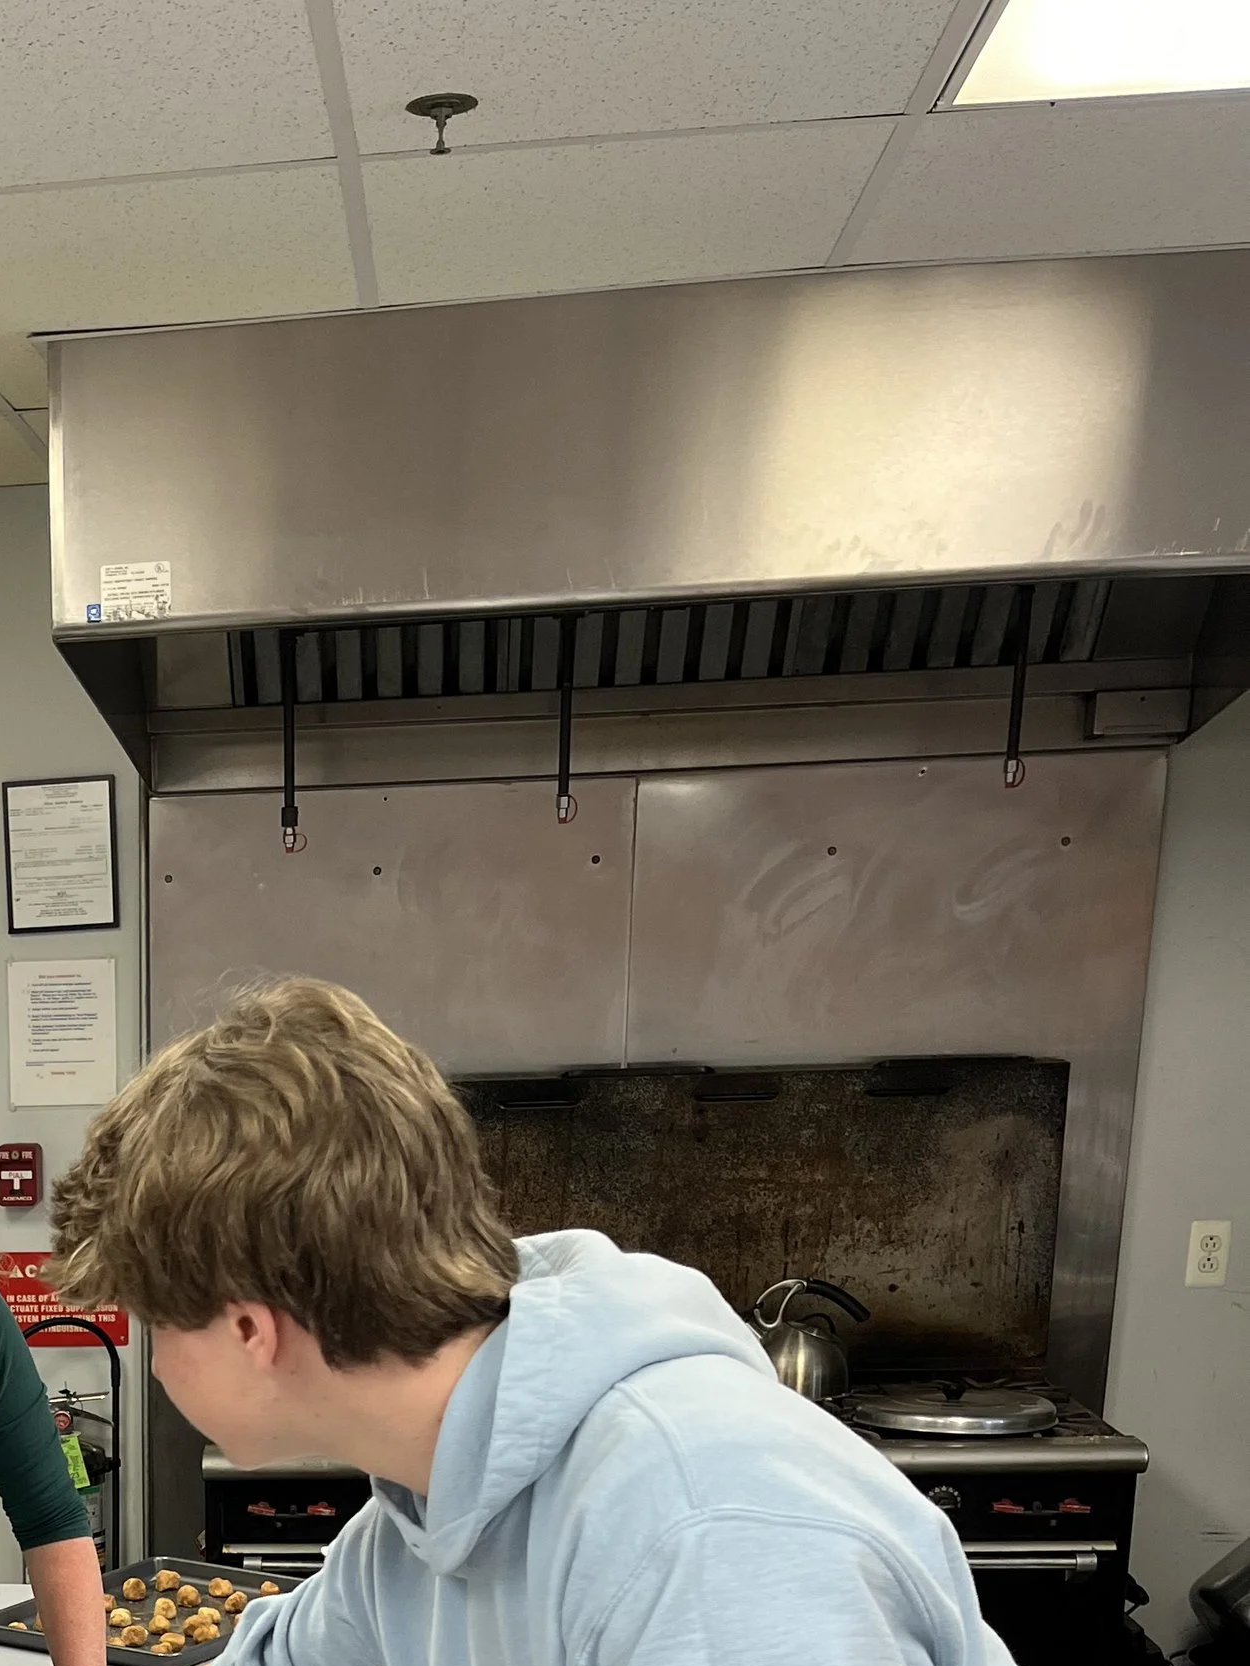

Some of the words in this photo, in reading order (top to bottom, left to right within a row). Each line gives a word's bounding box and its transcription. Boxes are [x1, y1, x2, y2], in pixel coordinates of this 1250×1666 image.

[0, 1152, 10, 1160] FIRE
[6, 1295, 14, 1303] IN
[10, 1305, 39, 1313] CTUATE
[41, 1305, 64, 1313] FIXED
[15, 1315, 39, 1323] YSTEM
[98, 1314, 116, 1322] THIS
